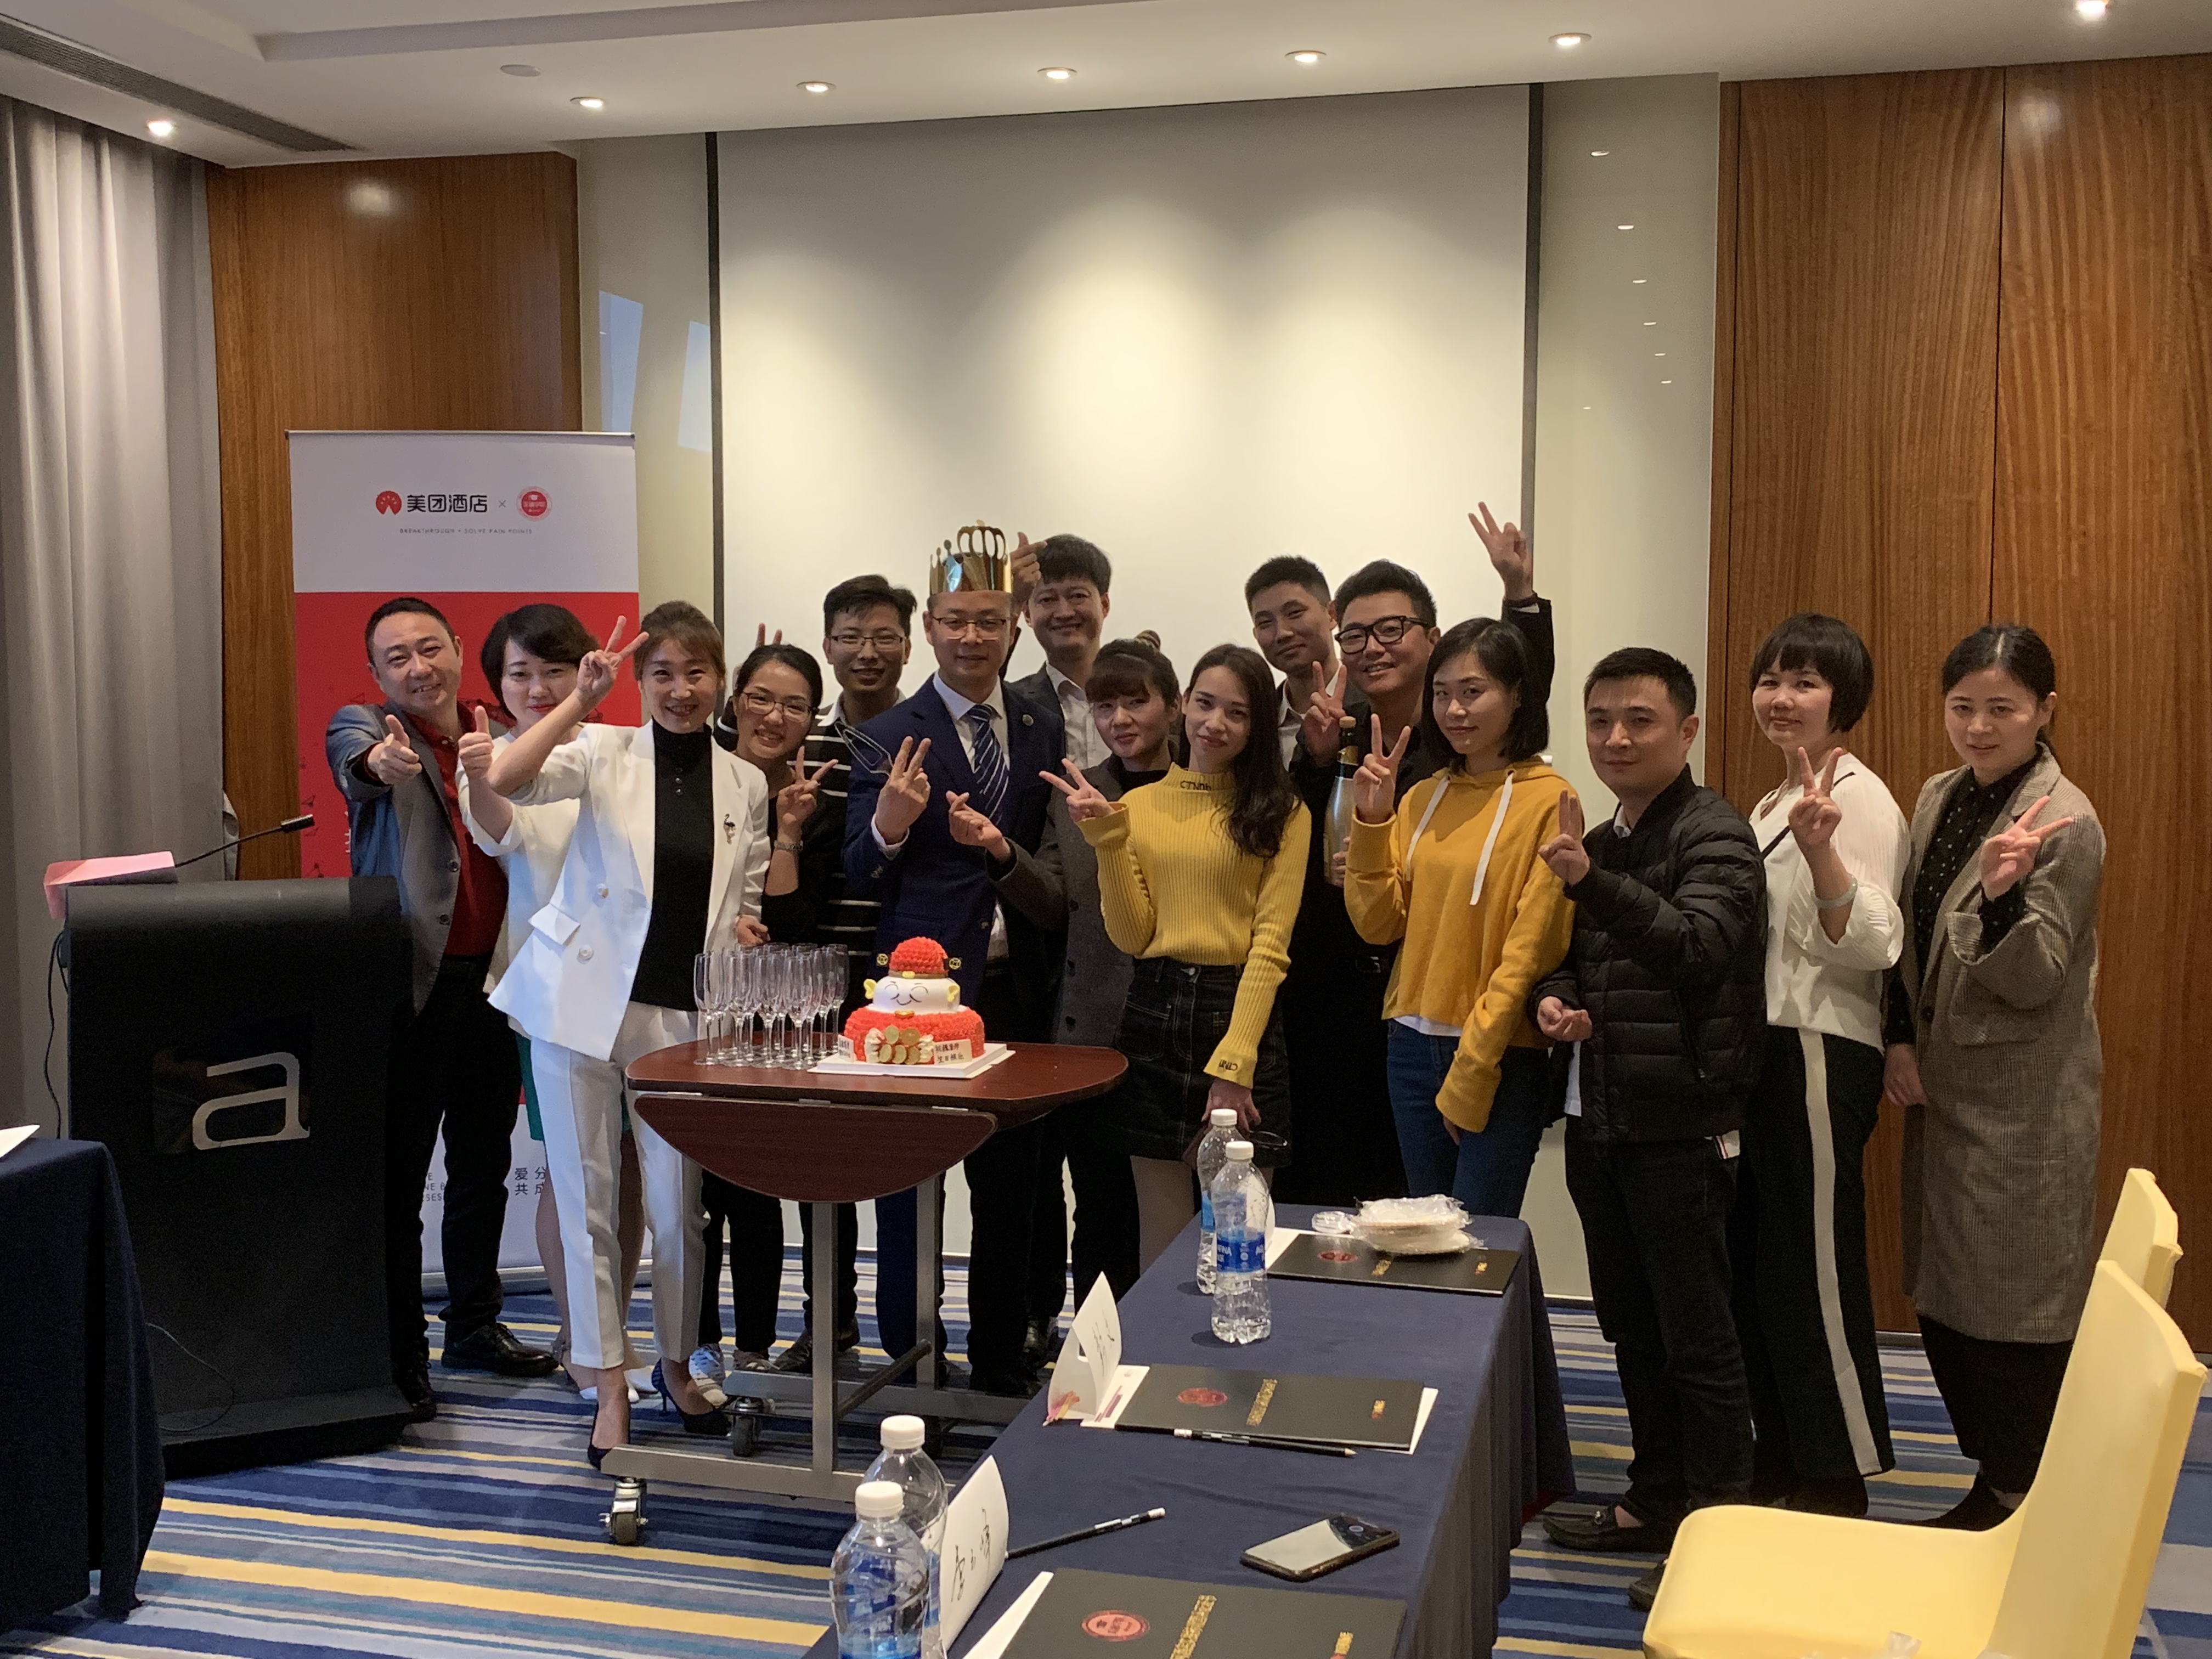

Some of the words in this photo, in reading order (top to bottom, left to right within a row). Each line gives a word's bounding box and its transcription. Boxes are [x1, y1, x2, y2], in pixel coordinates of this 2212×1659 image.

[407, 494, 487, 512] 美团酒店
[193, 1052, 311, 1150] a
